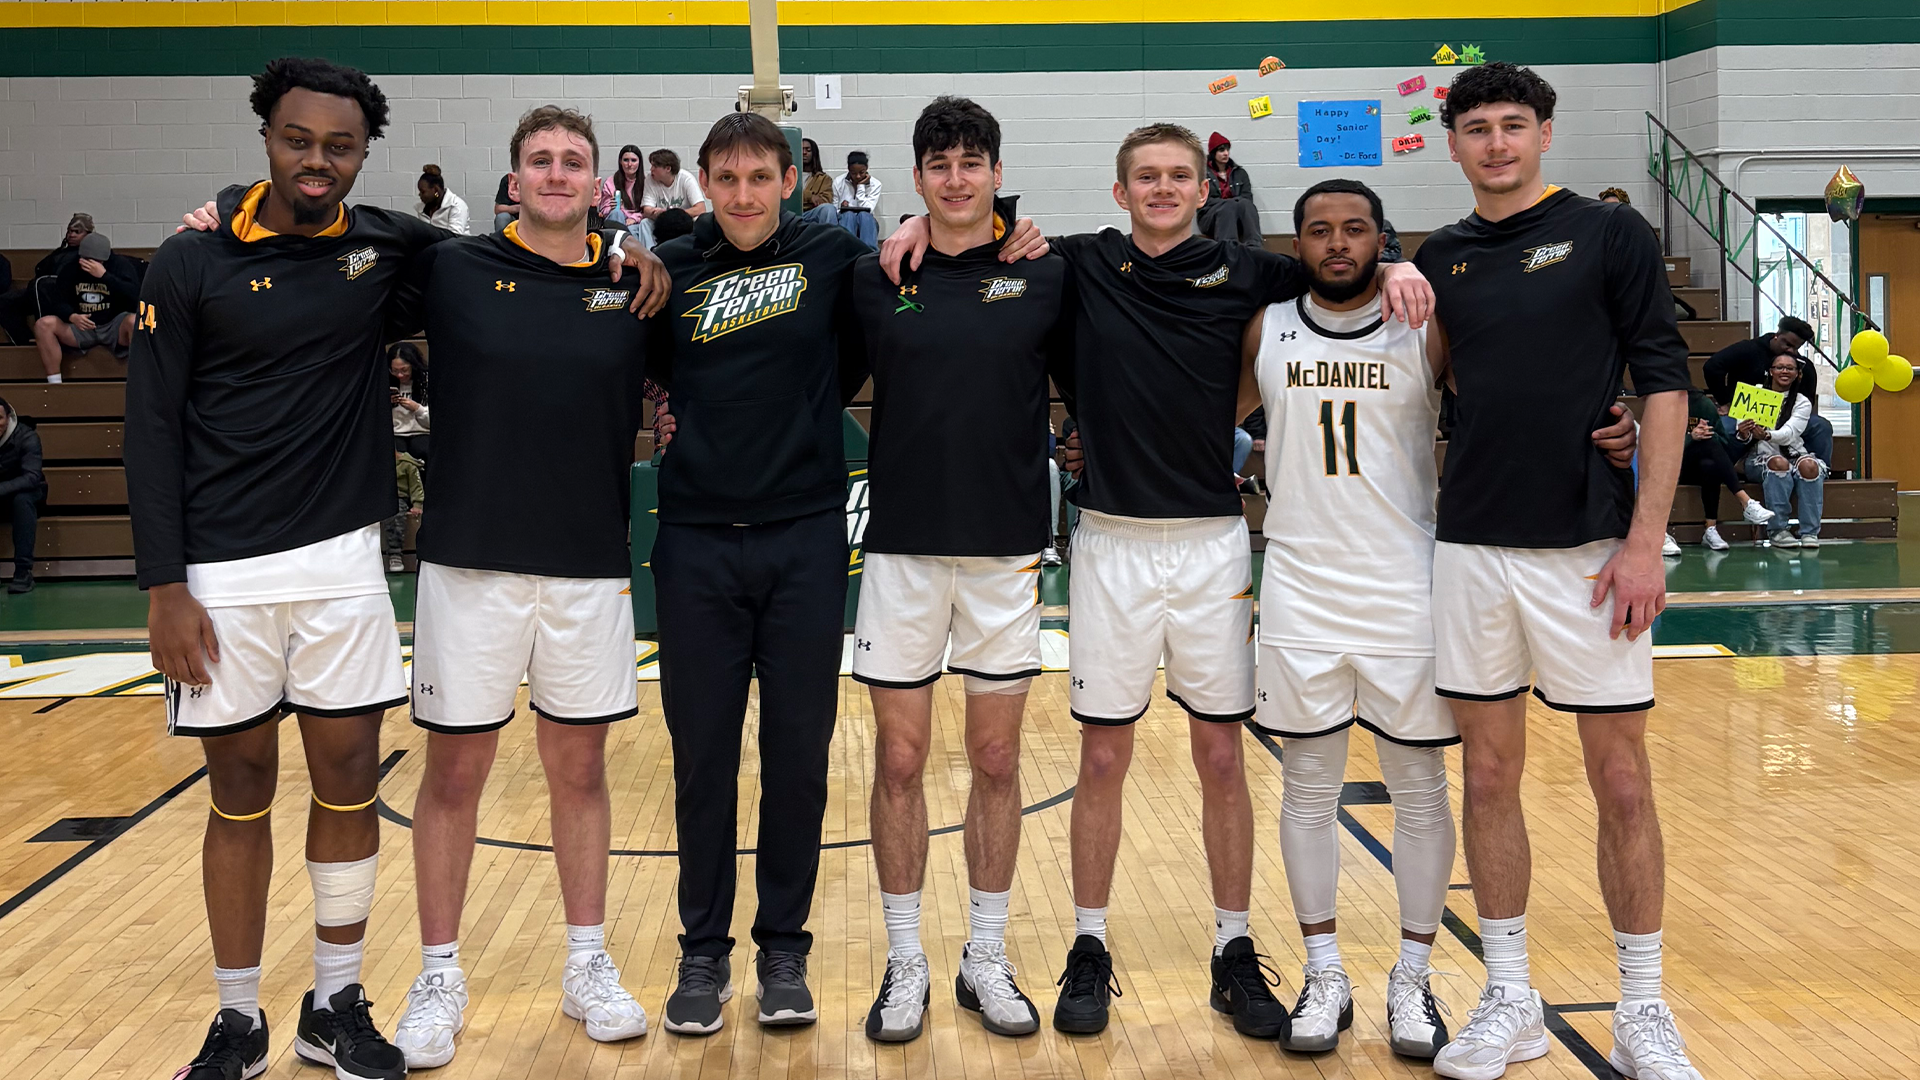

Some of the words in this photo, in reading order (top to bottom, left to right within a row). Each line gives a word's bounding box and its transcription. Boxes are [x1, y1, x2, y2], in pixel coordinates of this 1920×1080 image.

[825, 83, 831, 99] 1
[1315, 108, 1350, 118] Happy
[1336, 123, 1369, 132] Senior
[1316, 135, 1341, 144] Day!
[1358, 151, 1378, 160] Ford
[709, 267, 797, 305] Green
[701, 280, 802, 332] Terror
[711, 298, 792, 334] BASKETBALL
[1317, 399, 1361, 477] 11
